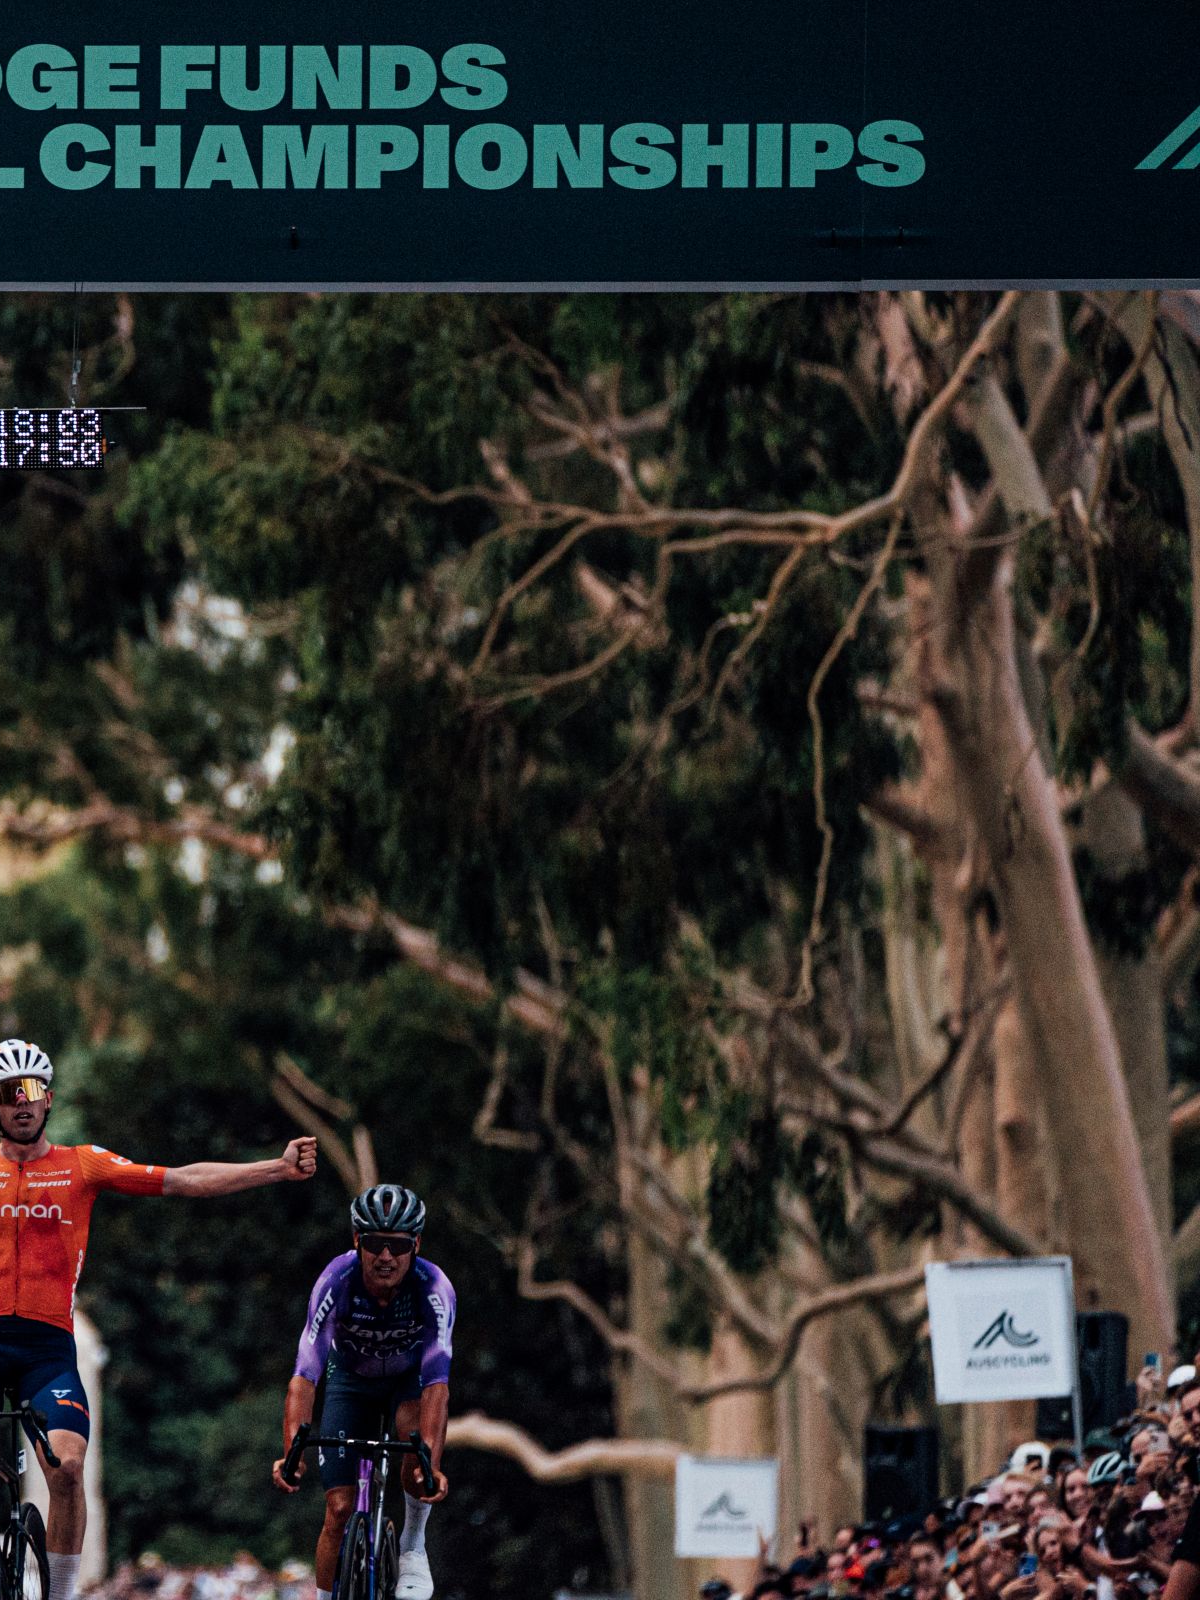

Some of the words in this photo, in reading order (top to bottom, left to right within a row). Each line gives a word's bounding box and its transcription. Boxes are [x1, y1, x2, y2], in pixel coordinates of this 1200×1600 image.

[160, 43, 508, 111] FUNDS
[39, 119, 926, 191] CHAMPIONSHIPS
[27, 1179, 72, 1189] SRAM
[307, 1288, 334, 1345] GIANT
[341, 1323, 424, 1342] Jayco
[966, 1352, 1052, 1371] AUSCYCLING
